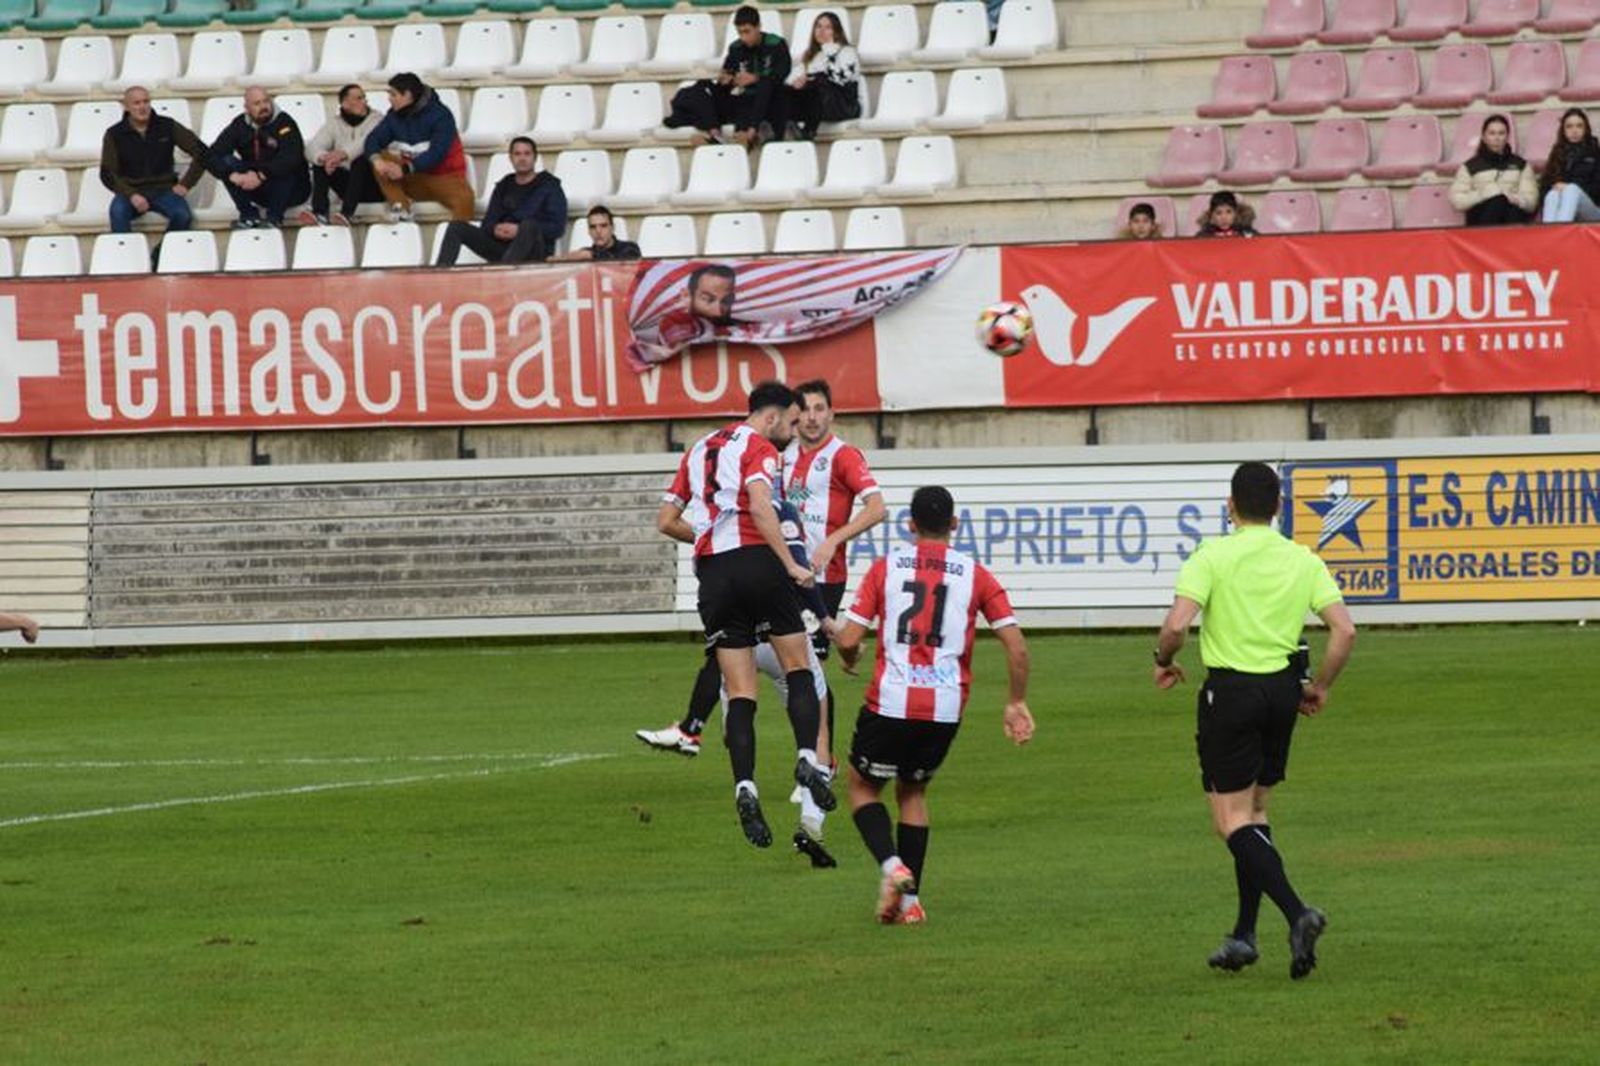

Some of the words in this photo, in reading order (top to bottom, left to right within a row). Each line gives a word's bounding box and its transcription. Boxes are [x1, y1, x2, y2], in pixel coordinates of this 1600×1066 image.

[1171, 270, 1559, 329] VALDERADUEY
[1176, 345, 1198, 361] EL
[1212, 341, 1292, 360] CENTRO
[1305, 335, 1426, 357] COMERCIAL
[1442, 334, 1466, 353] DE
[1480, 332, 1564, 352] ZAMORA
[1408, 471, 1473, 528] E.S.
[1486, 468, 1600, 526] CAMIN
[1408, 551, 1559, 580] MORALES
[896, 581, 949, 648] 21
